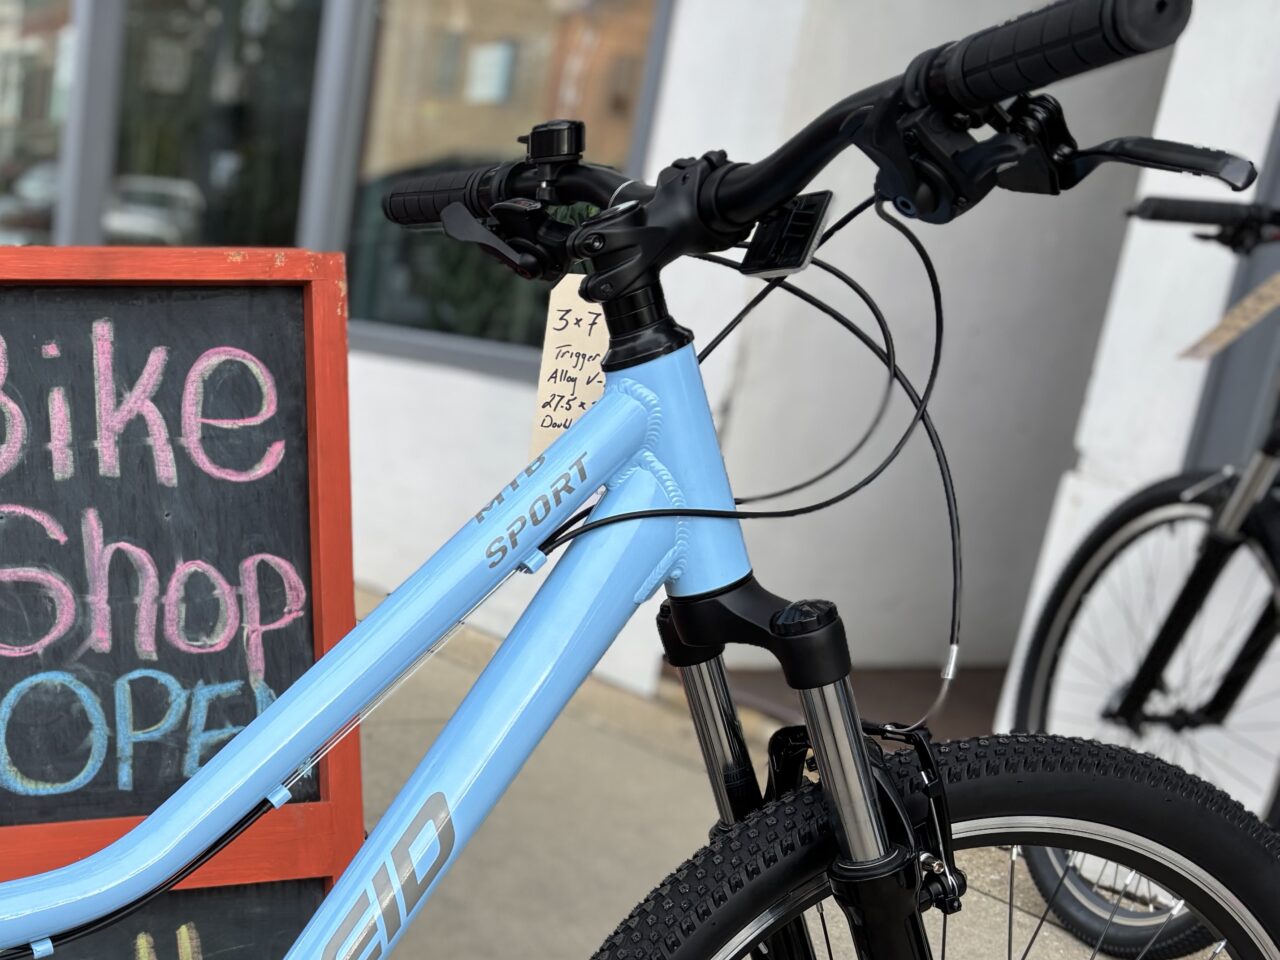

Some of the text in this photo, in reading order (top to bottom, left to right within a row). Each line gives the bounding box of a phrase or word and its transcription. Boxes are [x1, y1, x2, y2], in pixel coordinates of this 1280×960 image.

[555, 344, 601, 371] Trigger
[547, 368, 578, 396] Alloy
[485, 451, 588, 569] SPORT
